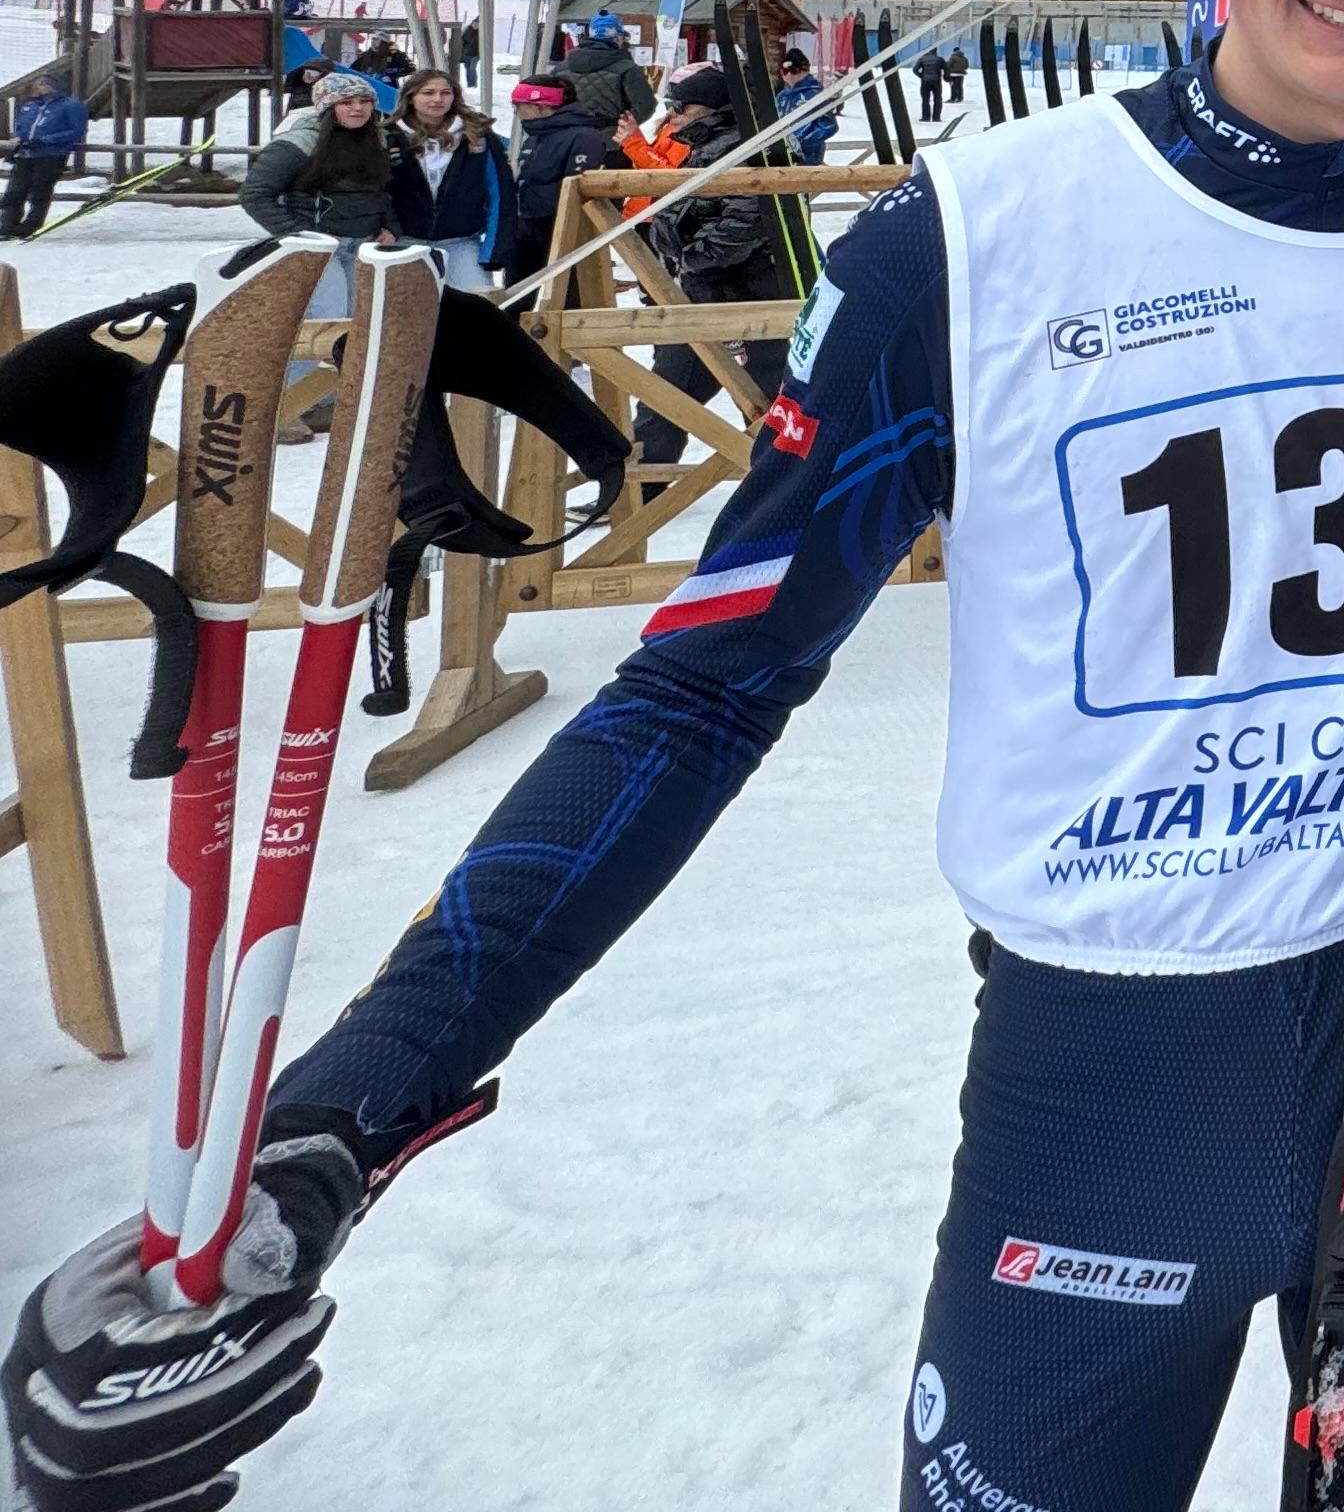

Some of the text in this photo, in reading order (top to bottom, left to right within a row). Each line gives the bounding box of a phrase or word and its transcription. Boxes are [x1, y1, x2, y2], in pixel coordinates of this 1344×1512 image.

[1187, 77, 1258, 150] CRAFT
[1113, 284, 1238, 320] GIACOMELLI
[1115, 297, 1257, 335] COSTRUZIONI
[1118, 330, 1193, 352] VALDIDENTRO
[1193, 722, 1286, 774] SCI
[275, 770, 320, 784] 45cm
[1049, 783, 1202, 851] ALTA
[1035, 1255, 1190, 1293] Jean Lain
[78, 1319, 267, 1410] swix
